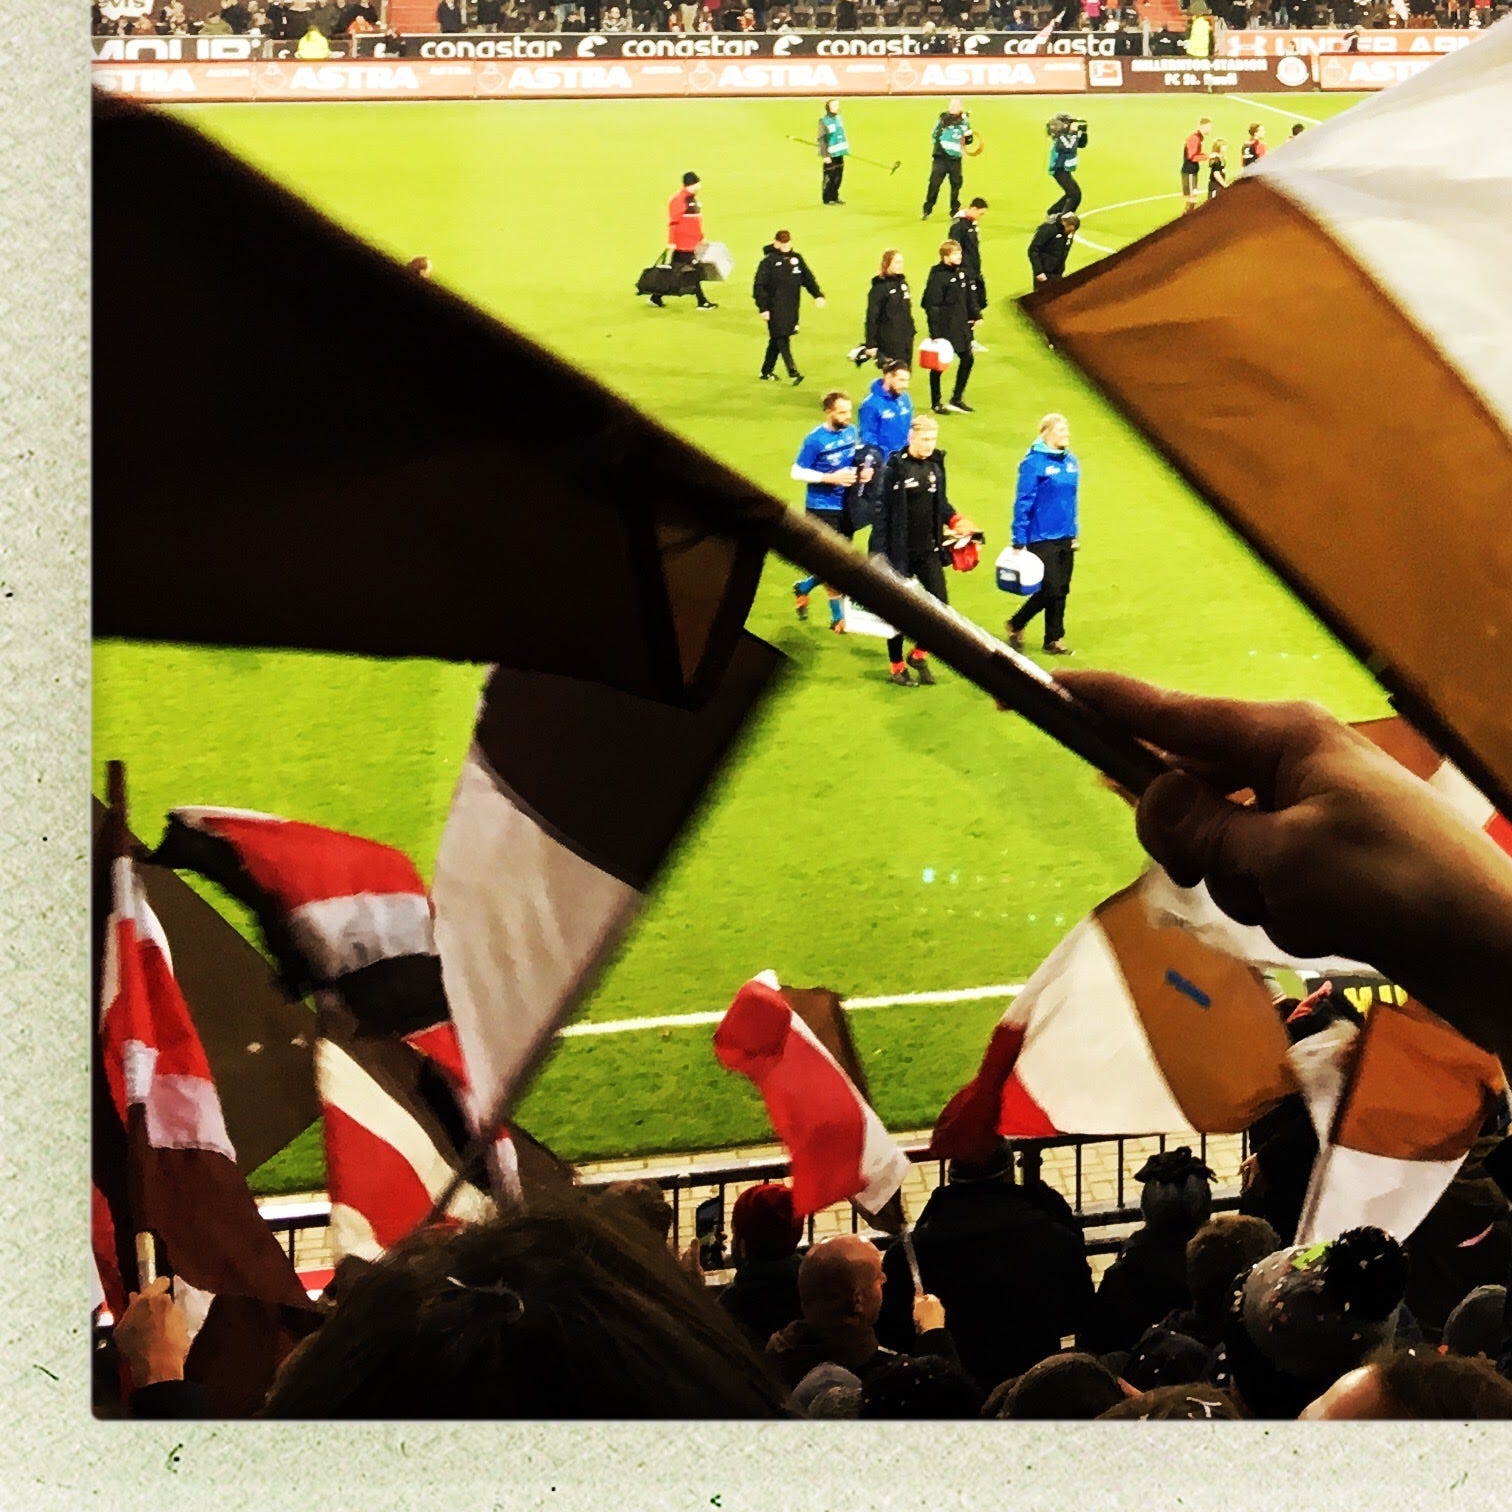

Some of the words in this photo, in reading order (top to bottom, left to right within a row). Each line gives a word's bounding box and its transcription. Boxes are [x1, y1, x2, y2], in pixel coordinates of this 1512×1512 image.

[92, 67, 197, 92] STRA
[289, 64, 421, 91] ASTRA
[508, 65, 633, 89] ASTRA
[717, 64, 840, 87] ASTRA
[920, 62, 1037, 86] ASTRA
